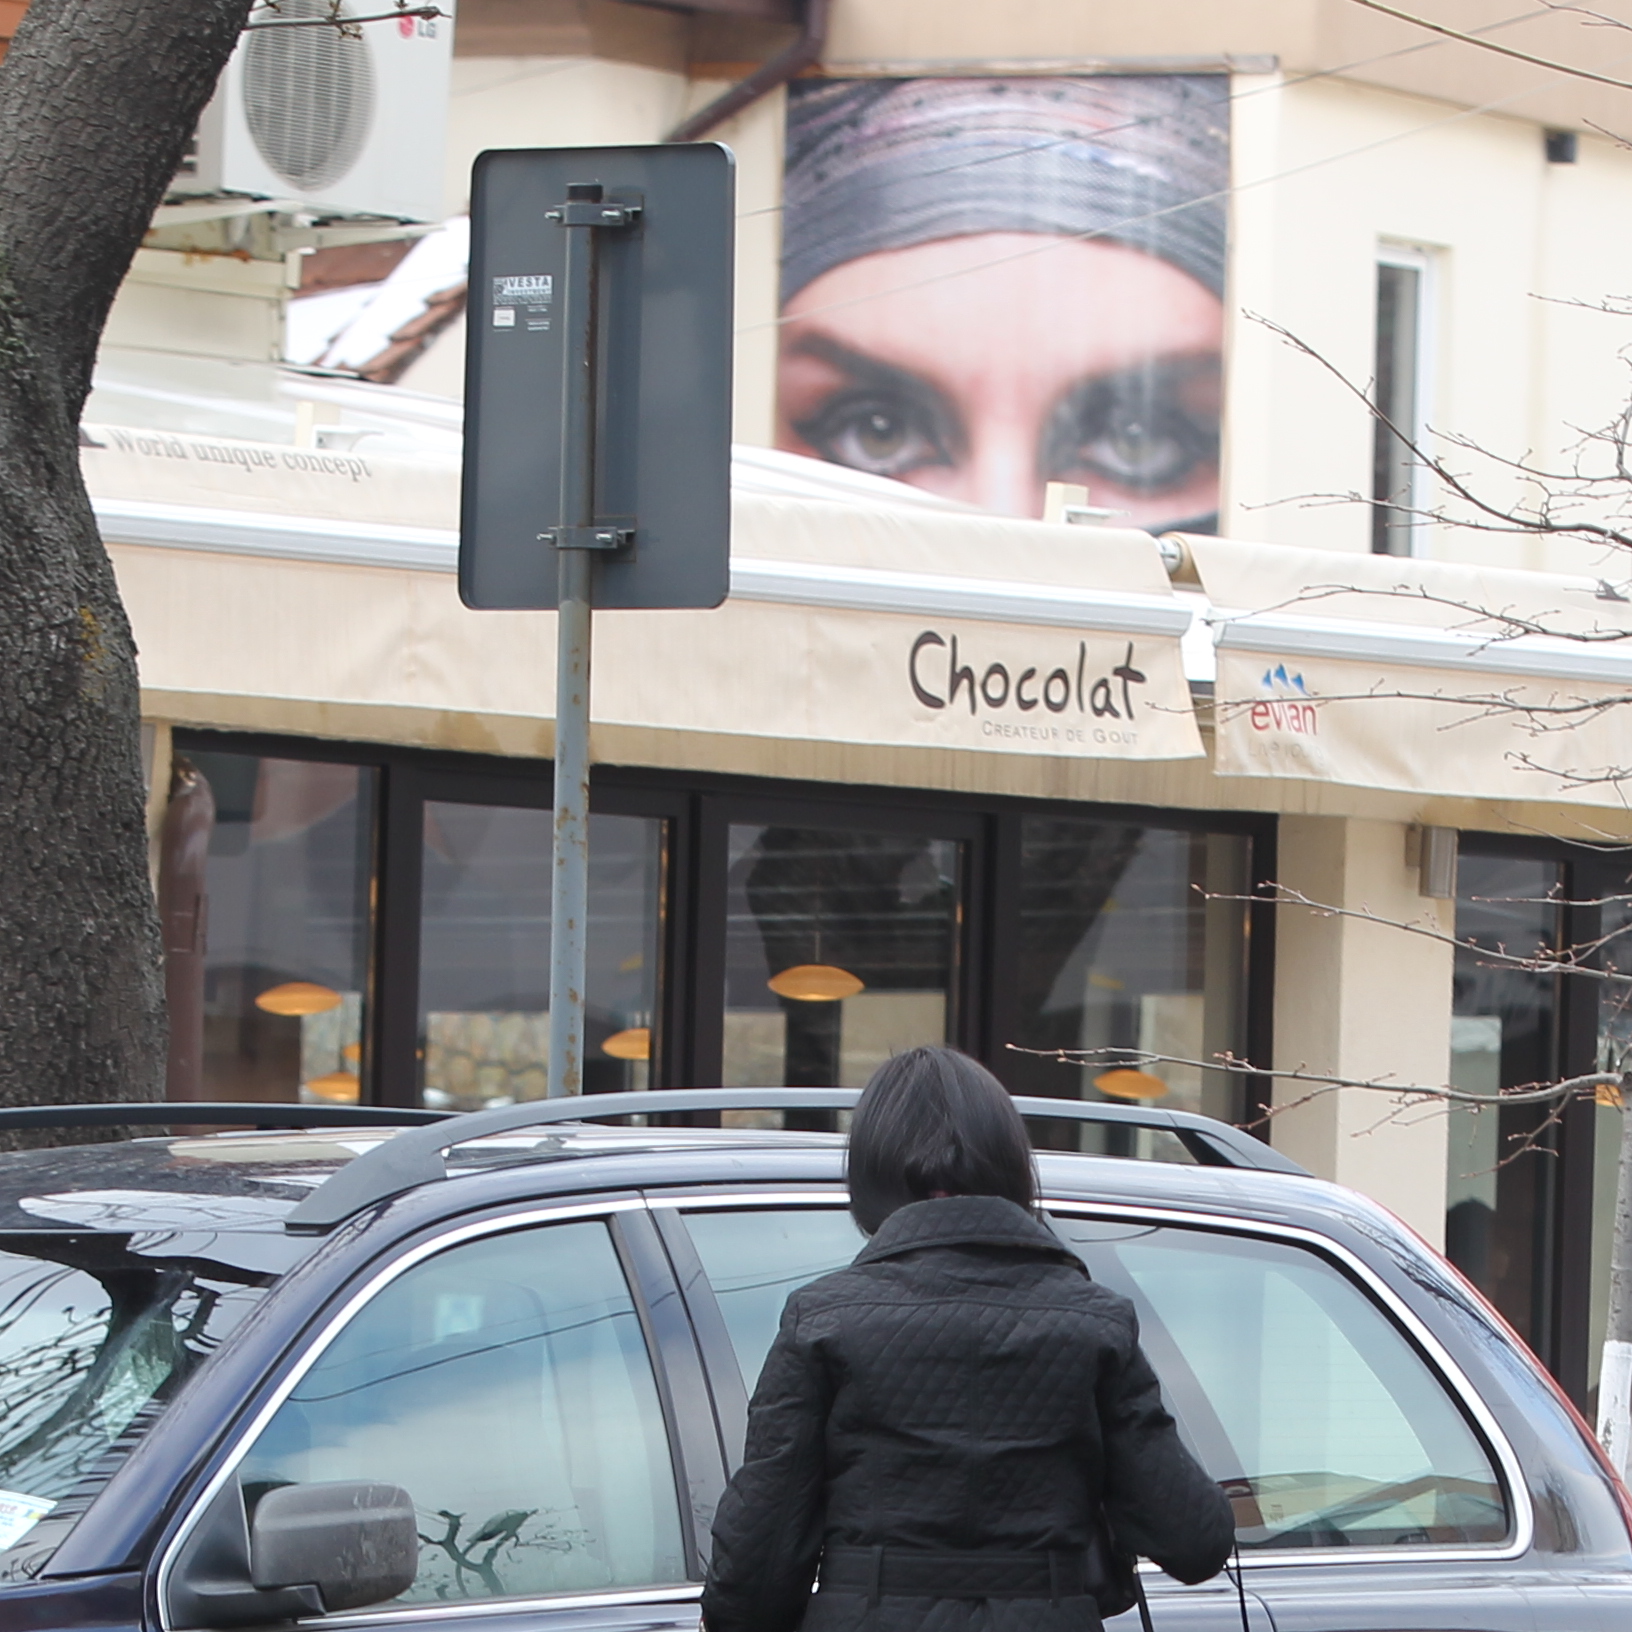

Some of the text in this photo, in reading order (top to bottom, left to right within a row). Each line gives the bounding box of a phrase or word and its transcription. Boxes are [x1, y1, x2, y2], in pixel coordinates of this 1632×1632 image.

[508, 276, 550, 288] VESTA
[108, 429, 373, 482] World unique concept
[908, 630, 1147, 720] Chocolat
[981, 720, 1138, 745] CREATEUR DE GOUT
[1250, 700, 1318, 737] evian
